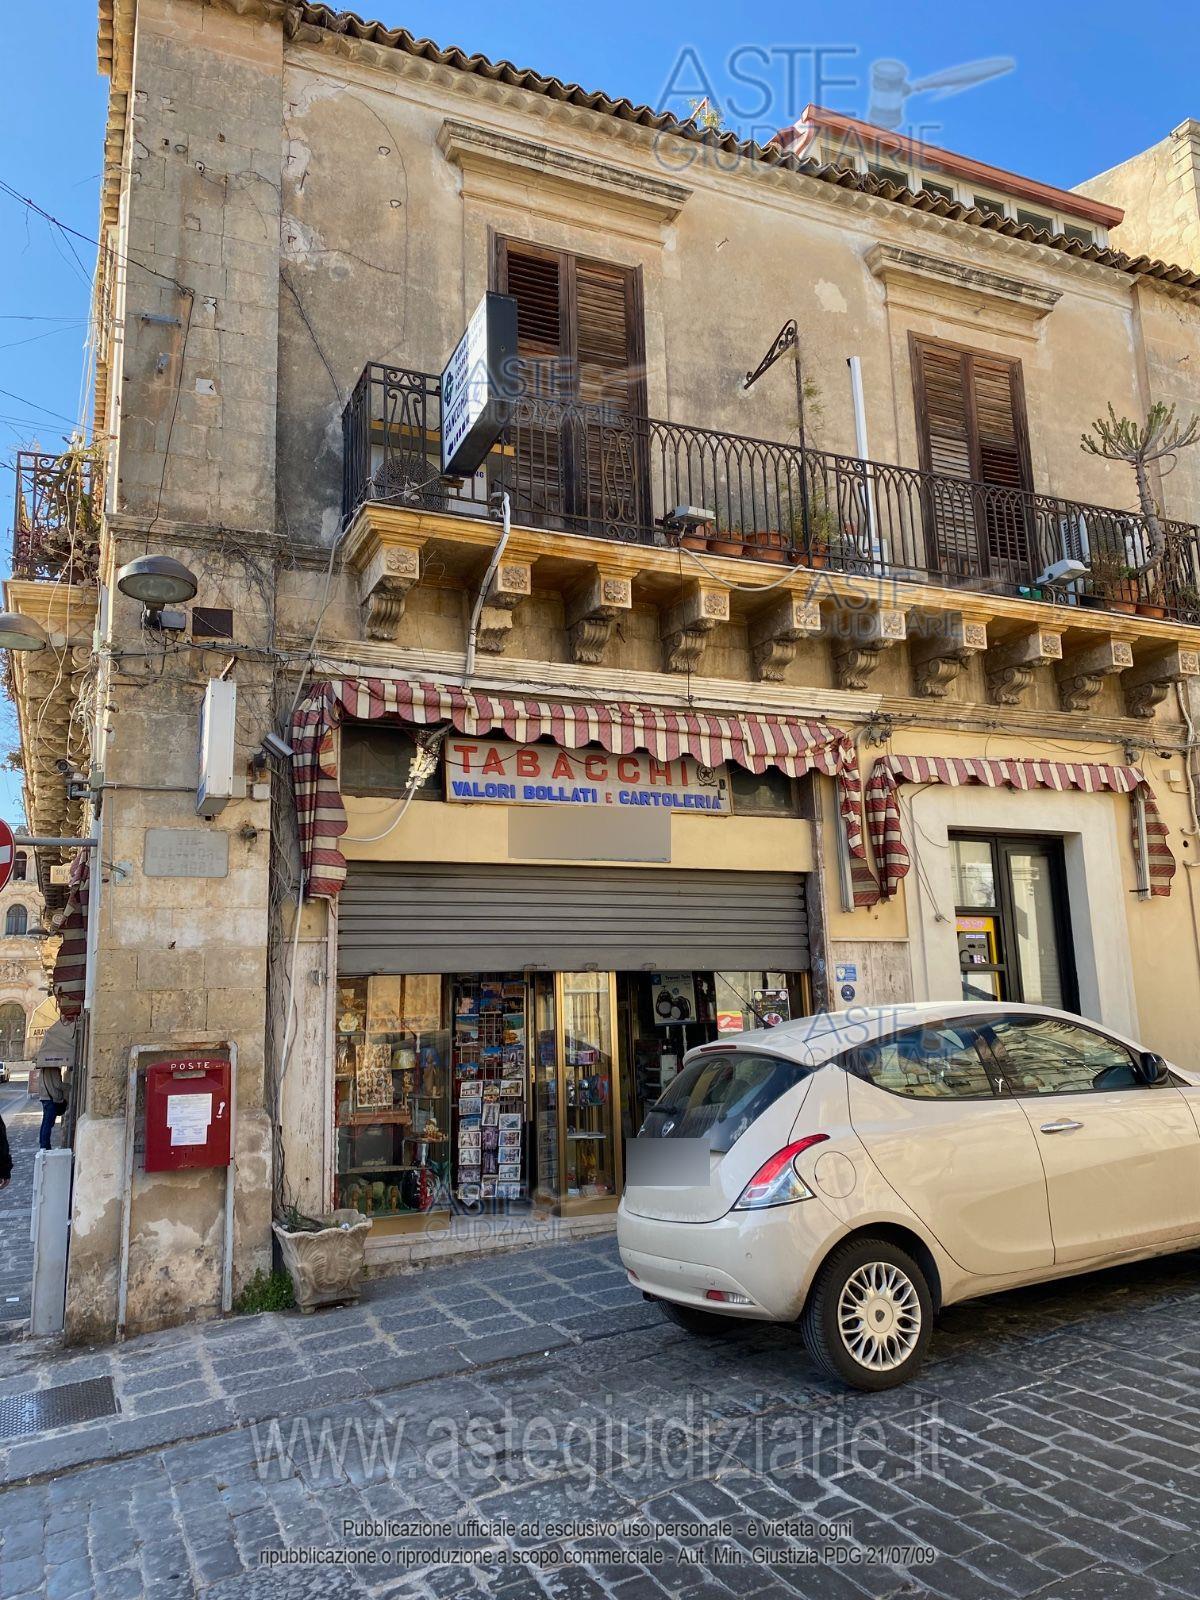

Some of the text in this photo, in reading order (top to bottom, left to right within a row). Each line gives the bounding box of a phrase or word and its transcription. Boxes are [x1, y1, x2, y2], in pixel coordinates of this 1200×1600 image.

[453, 744, 688, 787] TABACCHI
[452, 780, 722, 810] VALORI BOLLATI E CARTOLERIA
[170, 1061, 210, 1071] POSTE
